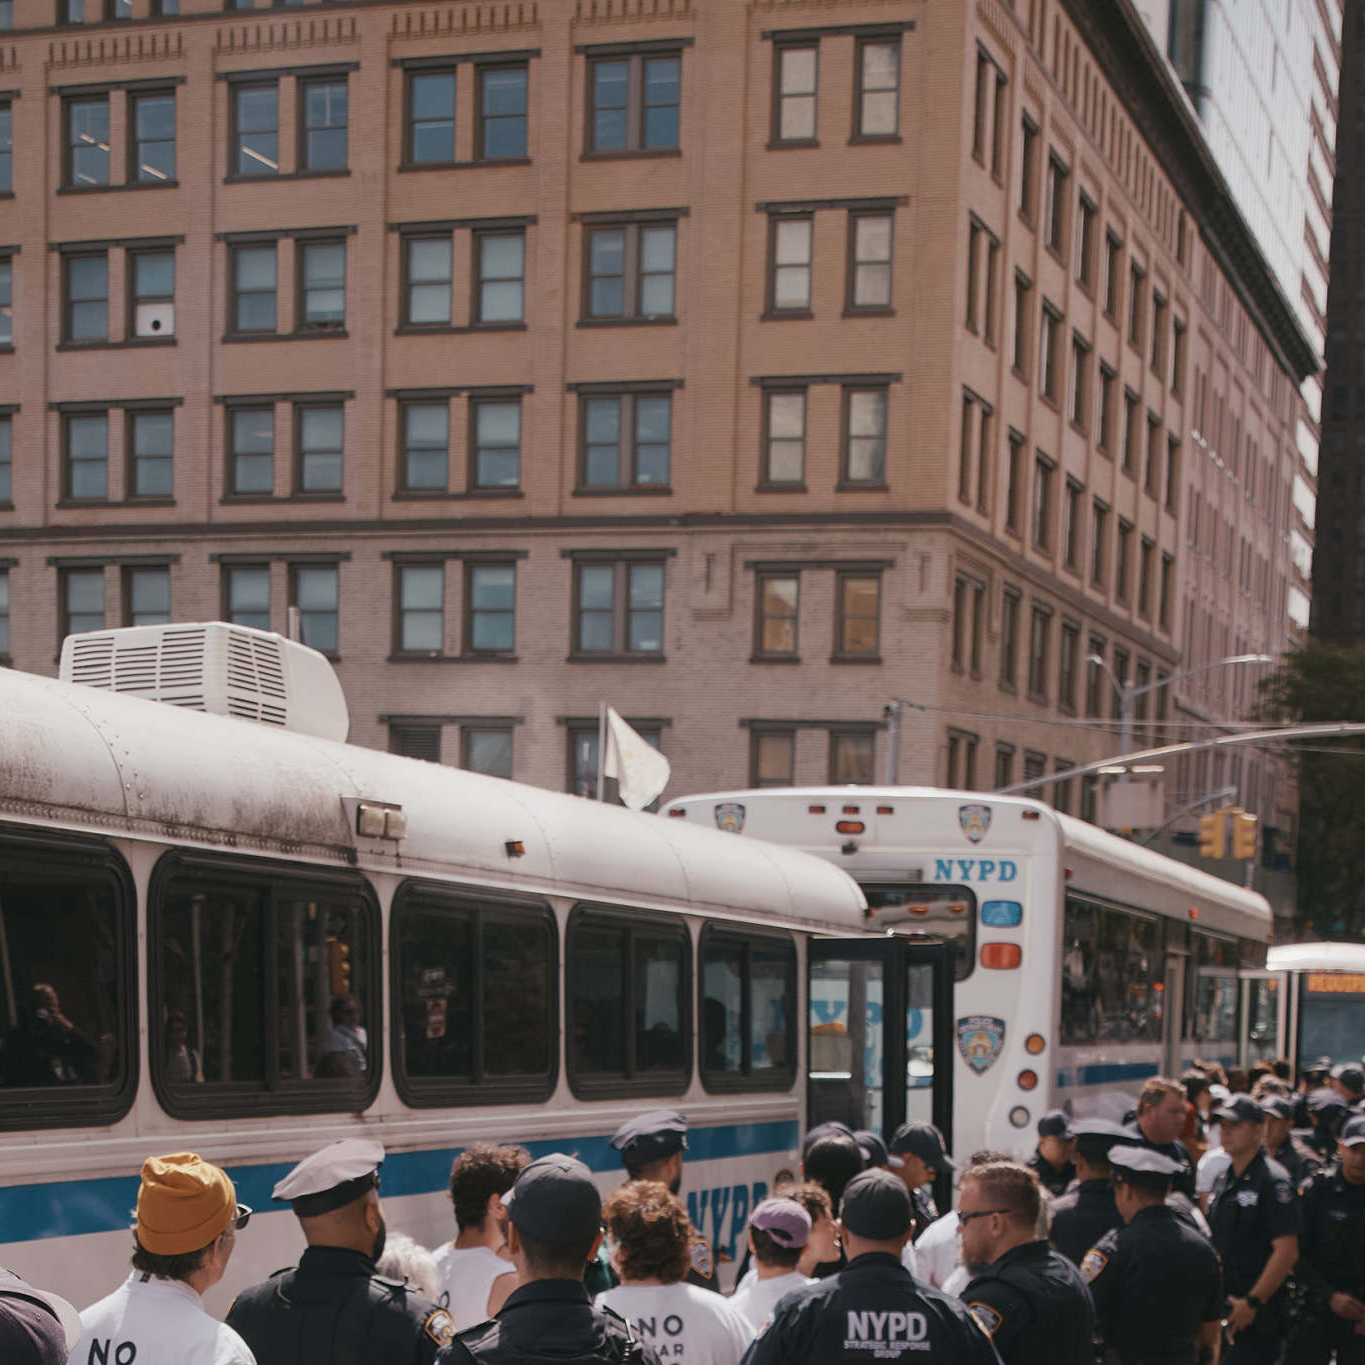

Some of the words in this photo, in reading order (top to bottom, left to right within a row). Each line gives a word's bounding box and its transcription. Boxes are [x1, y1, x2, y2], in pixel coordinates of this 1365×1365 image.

[935, 859, 1017, 882] NYPD
[638, 1315, 684, 1338] NO
[847, 1311, 927, 1341] NYPD
[659, 1344, 684, 1357] AR
